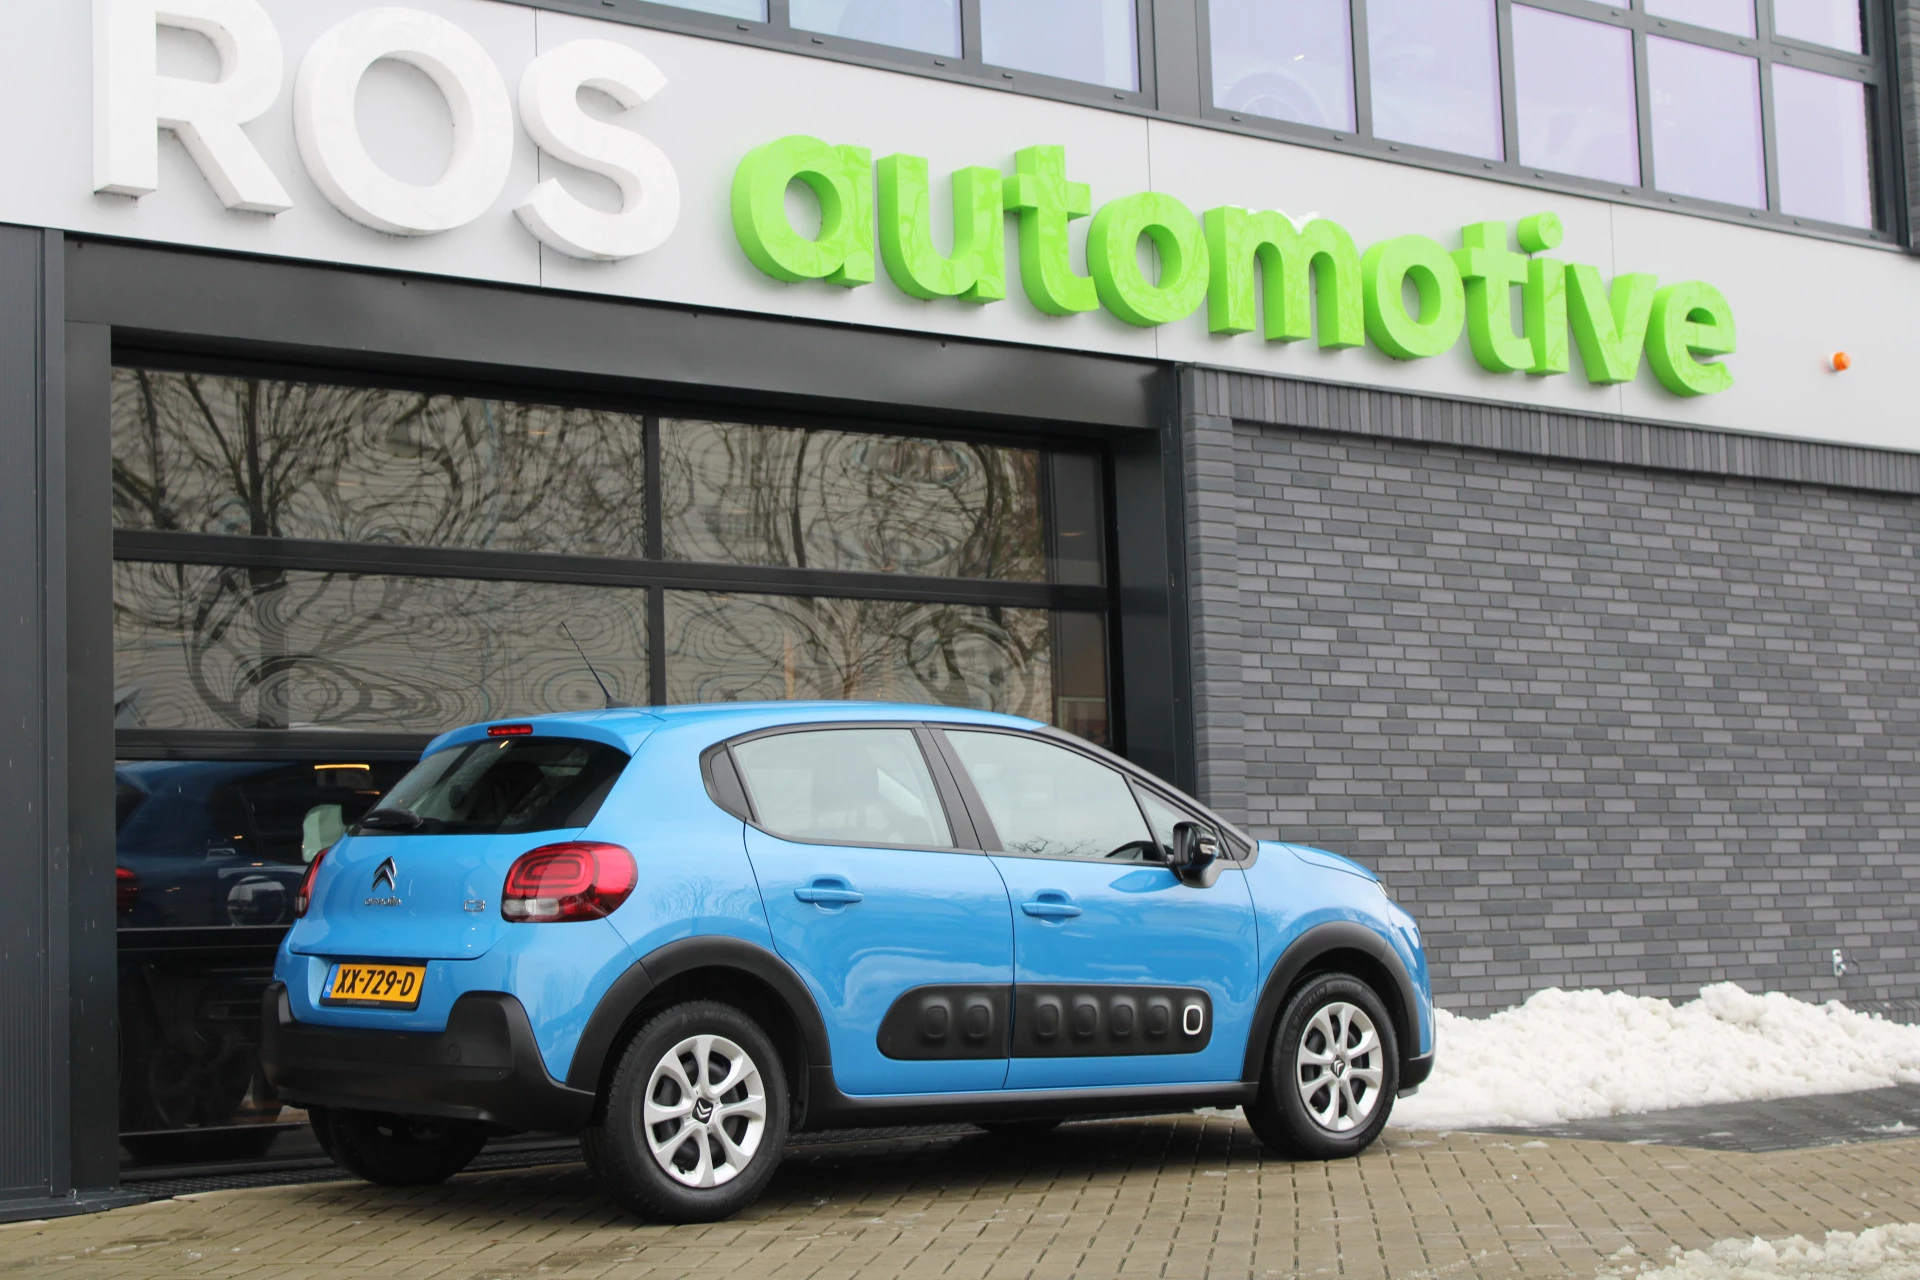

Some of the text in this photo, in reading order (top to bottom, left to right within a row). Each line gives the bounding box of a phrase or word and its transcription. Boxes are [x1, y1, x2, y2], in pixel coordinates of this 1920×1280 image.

[92, 0, 1736, 397] ROS automotive
[464, 900, 485, 912] C3
[335, 969, 416, 997] XX-729-D
